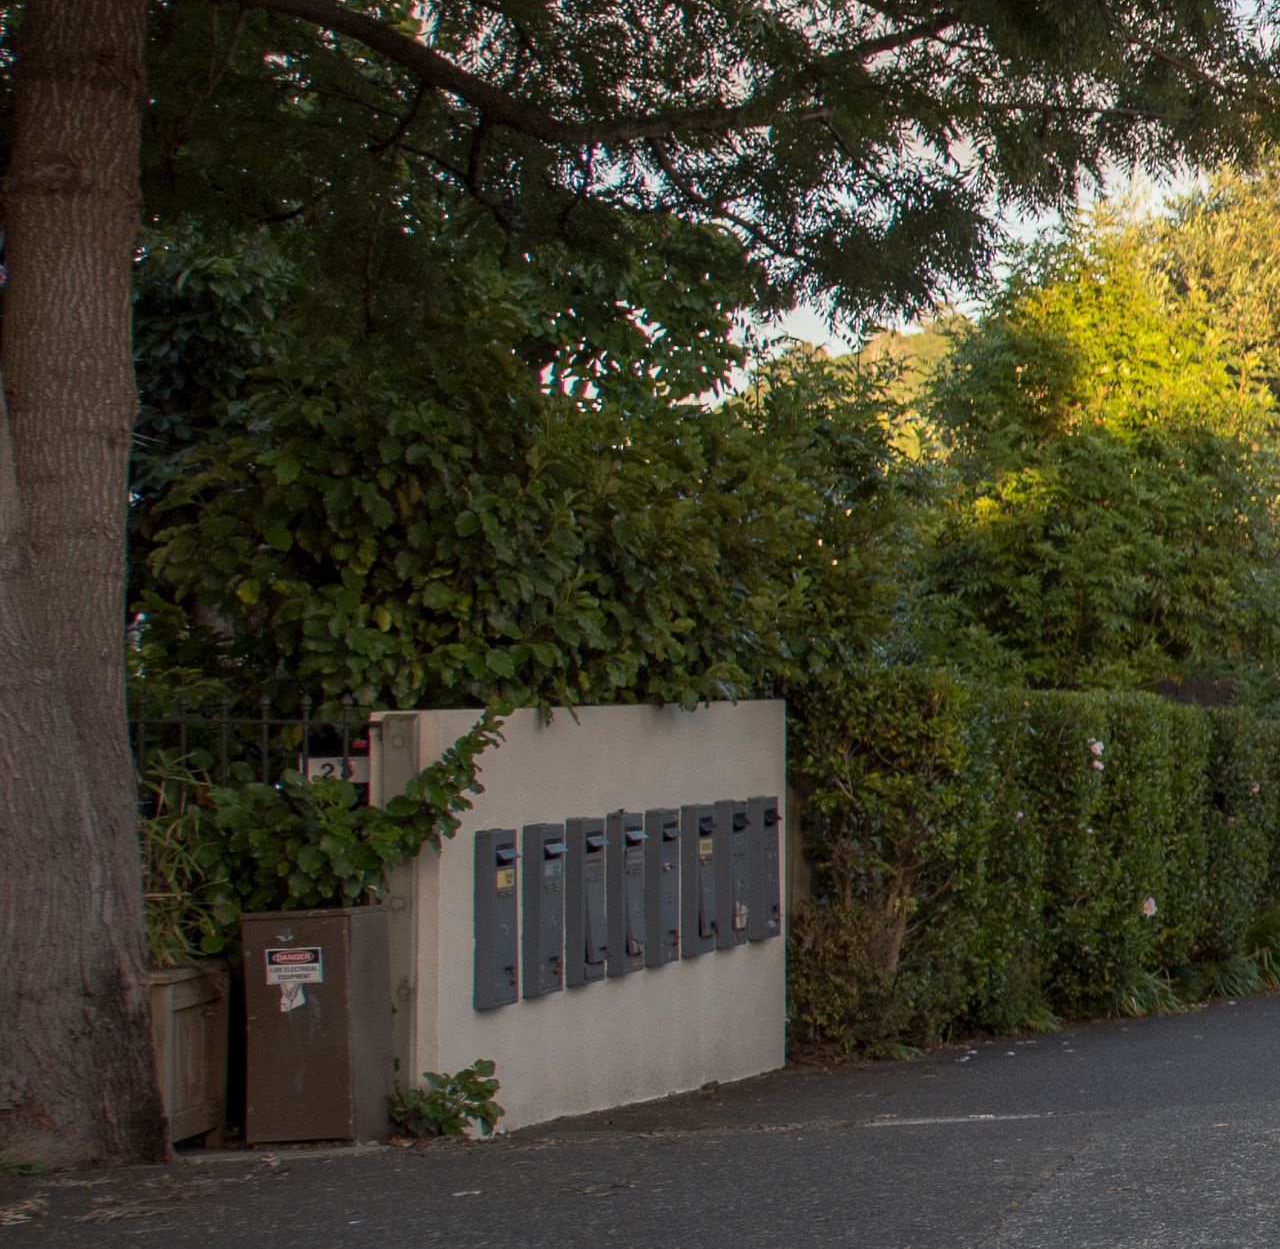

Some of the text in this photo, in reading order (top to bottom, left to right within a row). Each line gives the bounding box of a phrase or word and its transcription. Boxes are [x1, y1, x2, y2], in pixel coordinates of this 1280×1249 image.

[276, 953, 311, 961] DANGER
[284, 965, 318, 973] ELECTRICAL
[277, 973, 312, 981] EQUIPMENT
